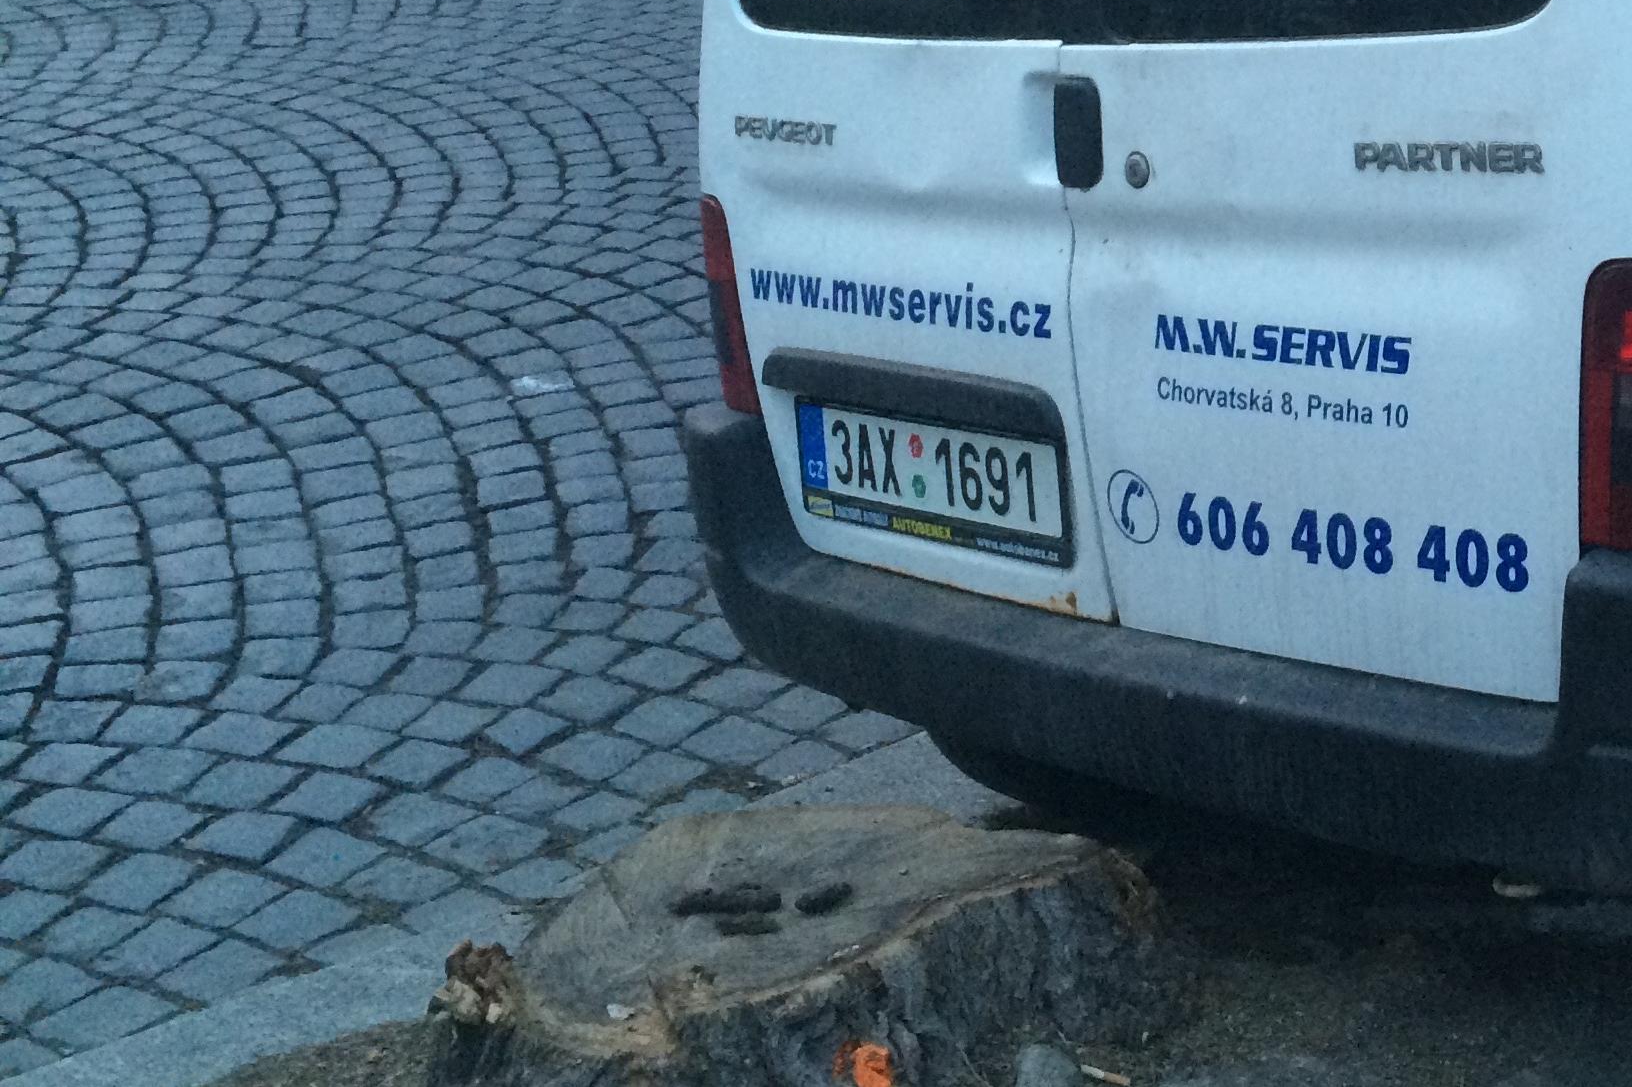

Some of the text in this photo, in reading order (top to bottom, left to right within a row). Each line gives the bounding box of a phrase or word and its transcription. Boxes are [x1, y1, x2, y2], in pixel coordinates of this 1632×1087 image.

[735, 115, 838, 146] PEUGEOT
[1353, 141, 1546, 174] PARTNER
[750, 267, 1052, 339] www.mwservis.cz
[1156, 376, 1409, 429] Chorvatská 8, Praha 10
[807, 459, 826, 480] CZ
[831, 419, 1038, 523] 3AX 1691
[1177, 491, 1530, 593] 606 408 408
